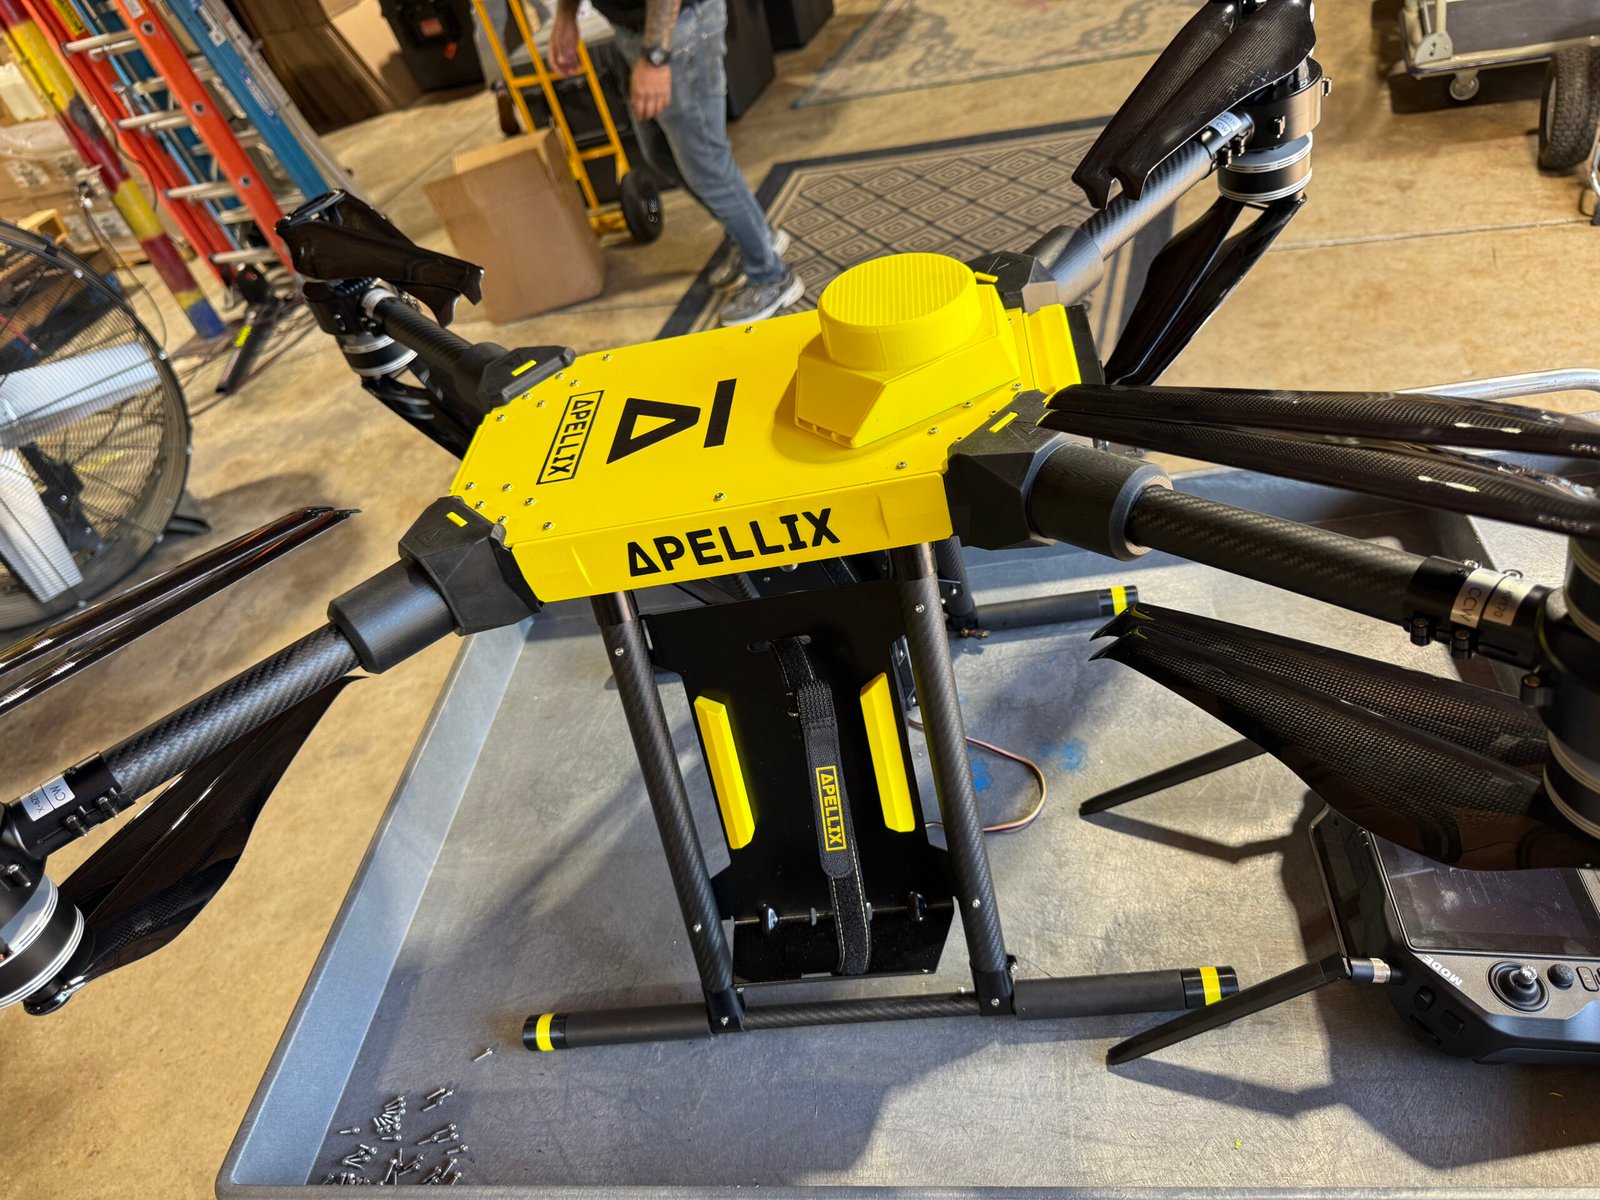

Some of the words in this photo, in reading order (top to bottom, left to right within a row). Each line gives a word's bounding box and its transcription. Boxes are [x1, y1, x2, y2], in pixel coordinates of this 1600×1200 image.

[1459, 587, 1482, 622] CCW
[49, 785, 66, 801] CW
[1423, 954, 1463, 986] MODE
